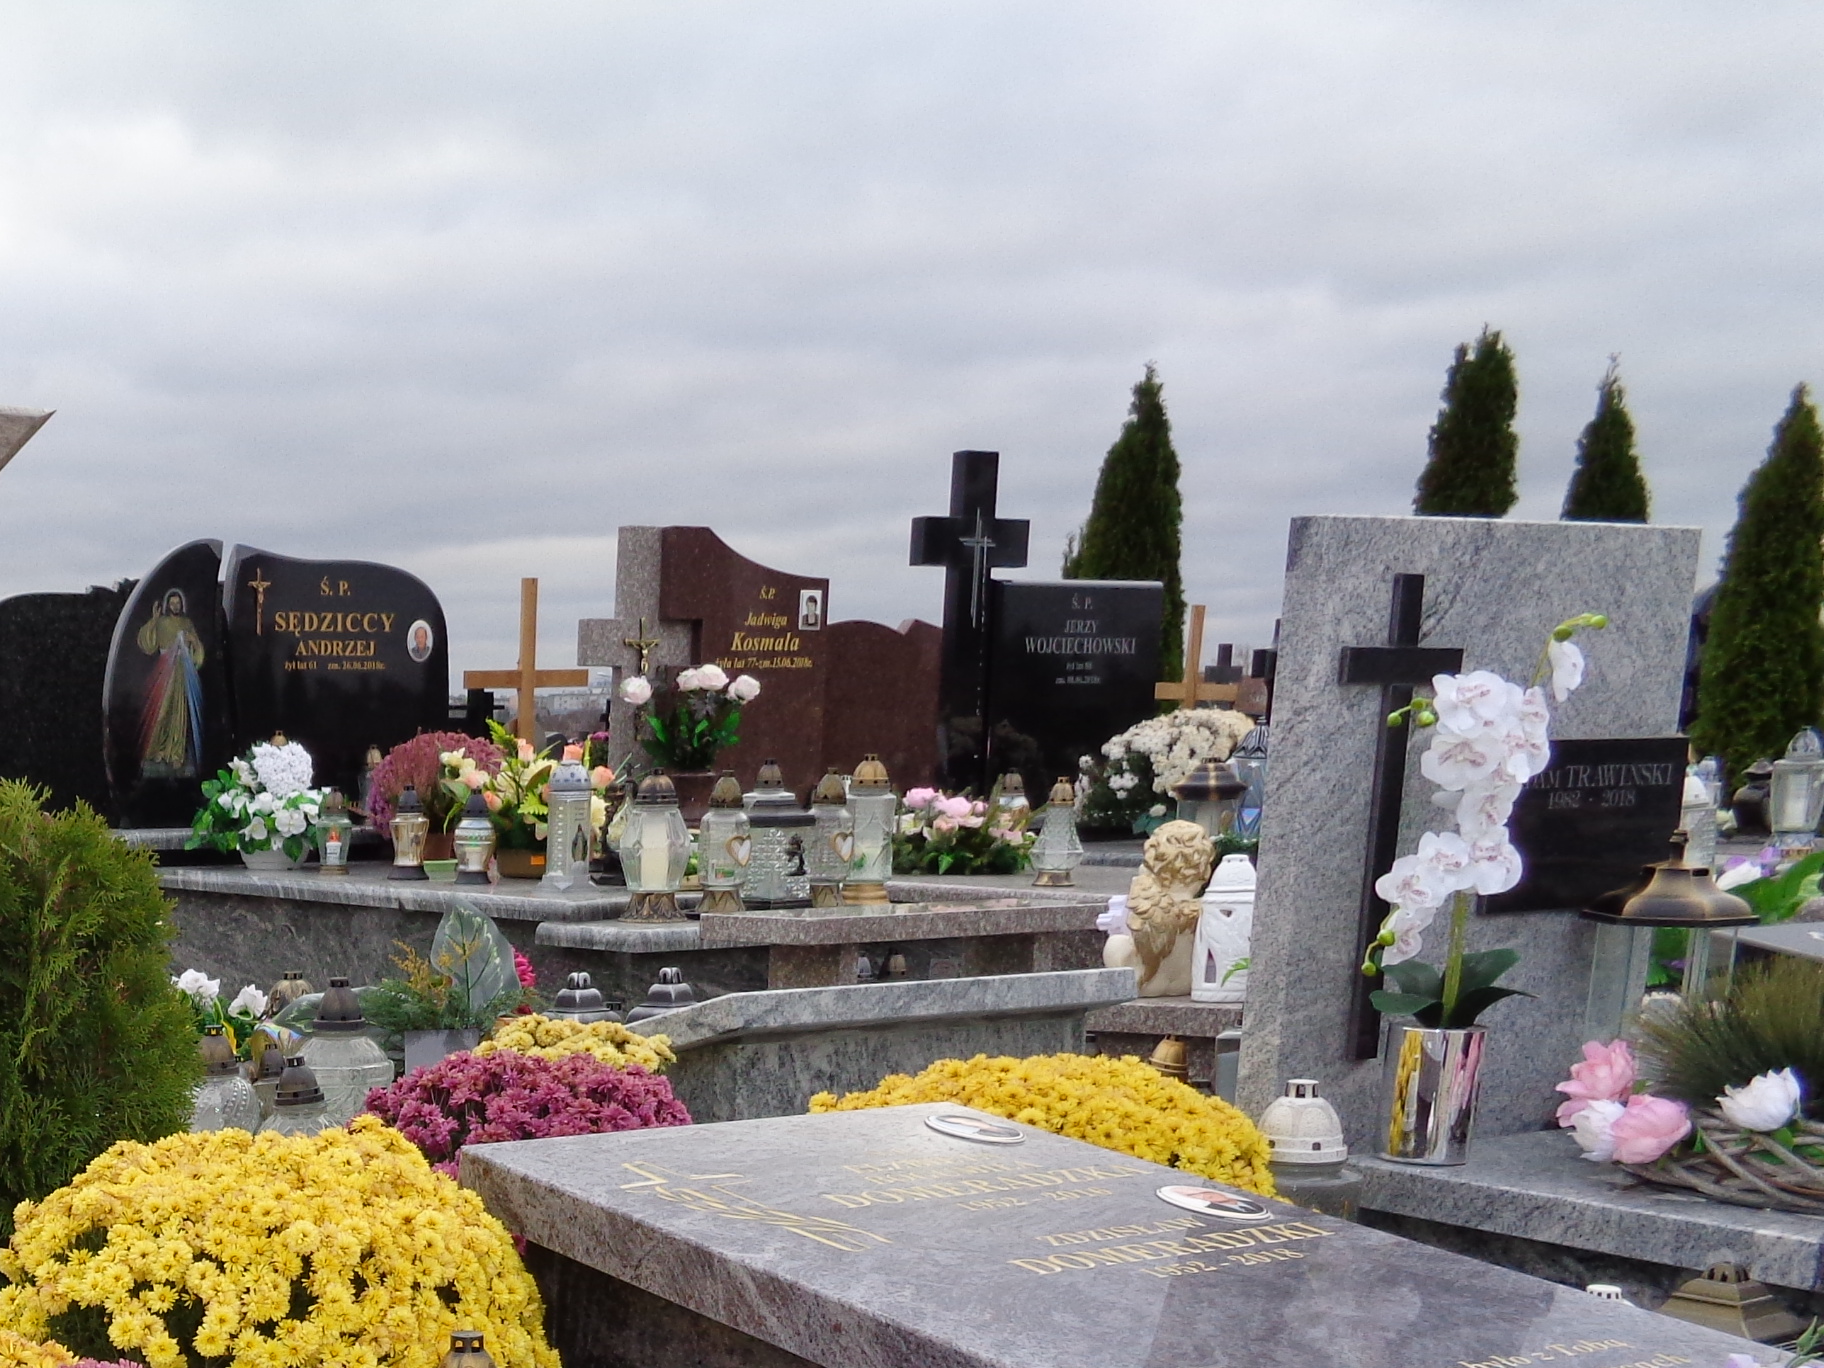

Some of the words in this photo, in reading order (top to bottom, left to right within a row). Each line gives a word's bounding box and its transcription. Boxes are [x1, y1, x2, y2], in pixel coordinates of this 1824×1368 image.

[275, 611, 395, 637] SĘDZICCY
[745, 611, 788, 629] Jadwiga
[1064, 619, 1097, 634] JERZY
[295, 640, 376, 657] ANDRZEJ
[731, 631, 800, 651] Kosmala
[1025, 637, 1136, 654] WOJCIECHOWSKI
[1600, 789, 1636, 808] 2018
[821, 1164, 1154, 1209] DOMERADZKA
[1036, 1216, 1207, 1247] ZDZISŁAW
[1006, 1222, 1336, 1275] DOMERADZKI
[1139, 1260, 1217, 1279] 1952
[1227, 1248, 1308, 1266] 2018
[1531, 1352, 1555, 1361] z
